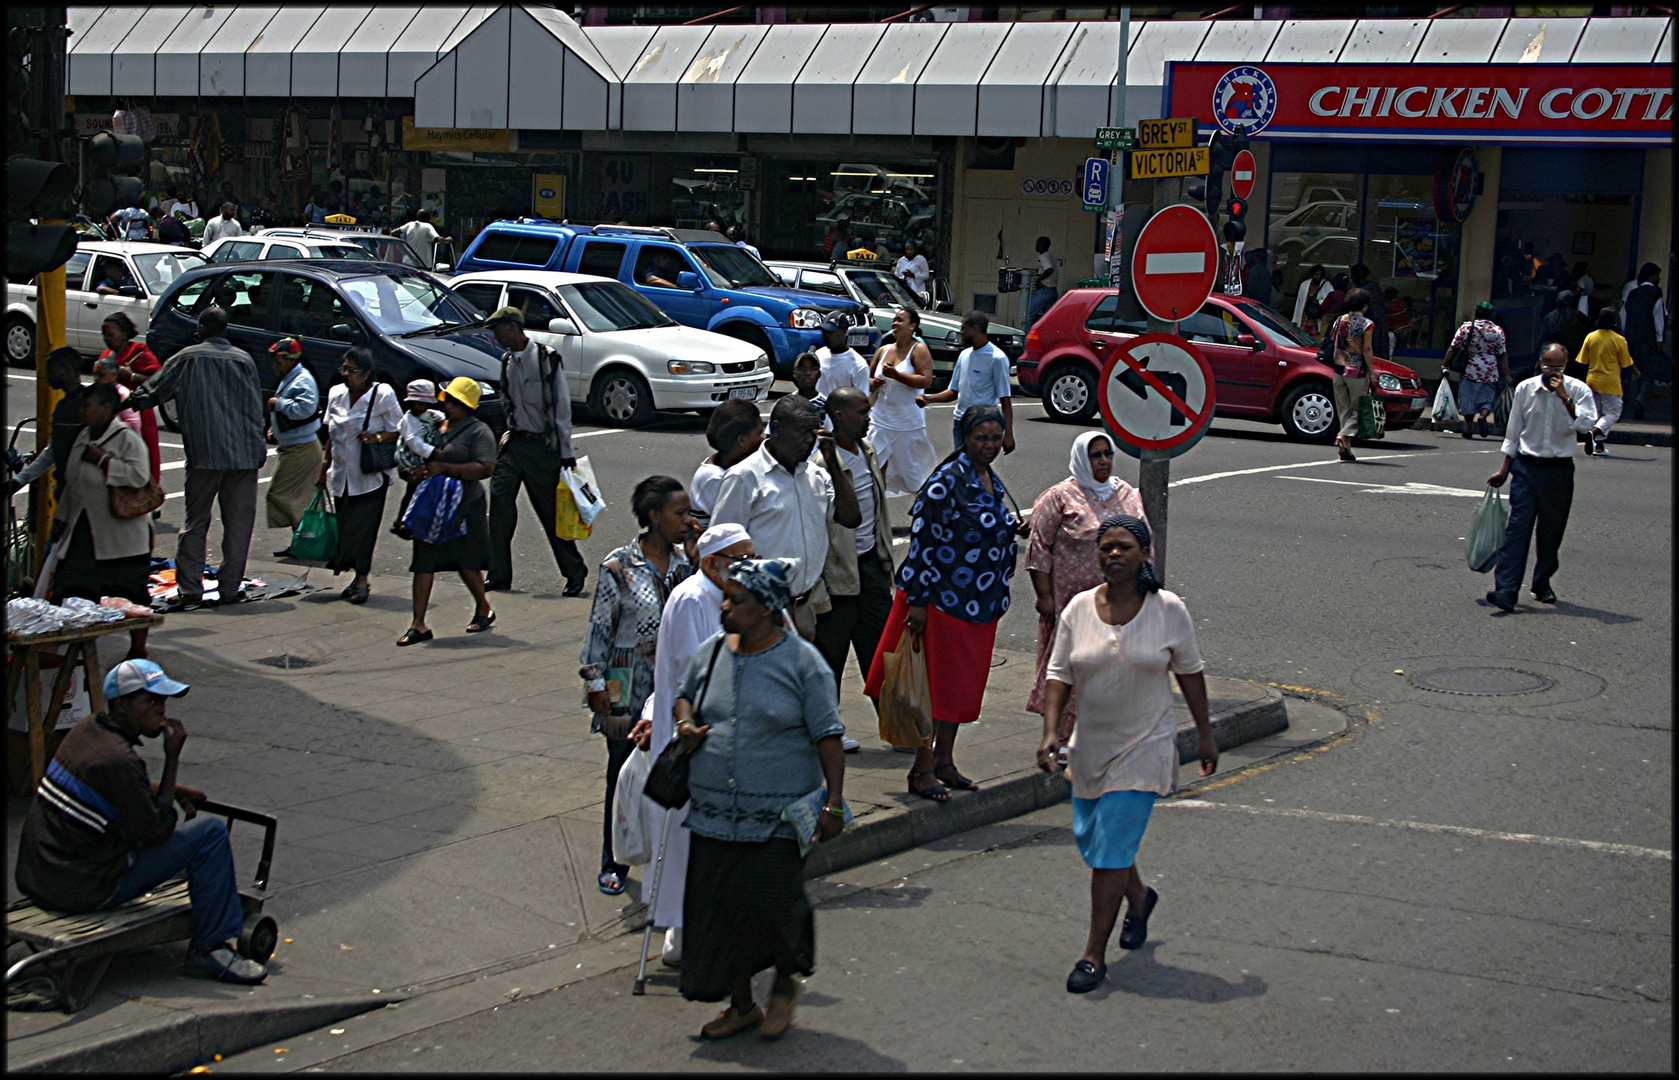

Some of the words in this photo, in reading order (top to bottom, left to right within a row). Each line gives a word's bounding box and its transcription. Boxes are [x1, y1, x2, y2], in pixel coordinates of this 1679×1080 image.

[1217, 69, 1273, 94] CHICKEN
[1308, 86, 1529, 119] CHICKEN
[427, 129, 461, 141] Haymits
[463, 129, 496, 140] Cellular
[1099, 131, 1120, 139] GREY
[1141, 123, 1177, 144] GREY
[1092, 162, 1101, 181] R
[1135, 152, 1196, 174] VICTORIA
